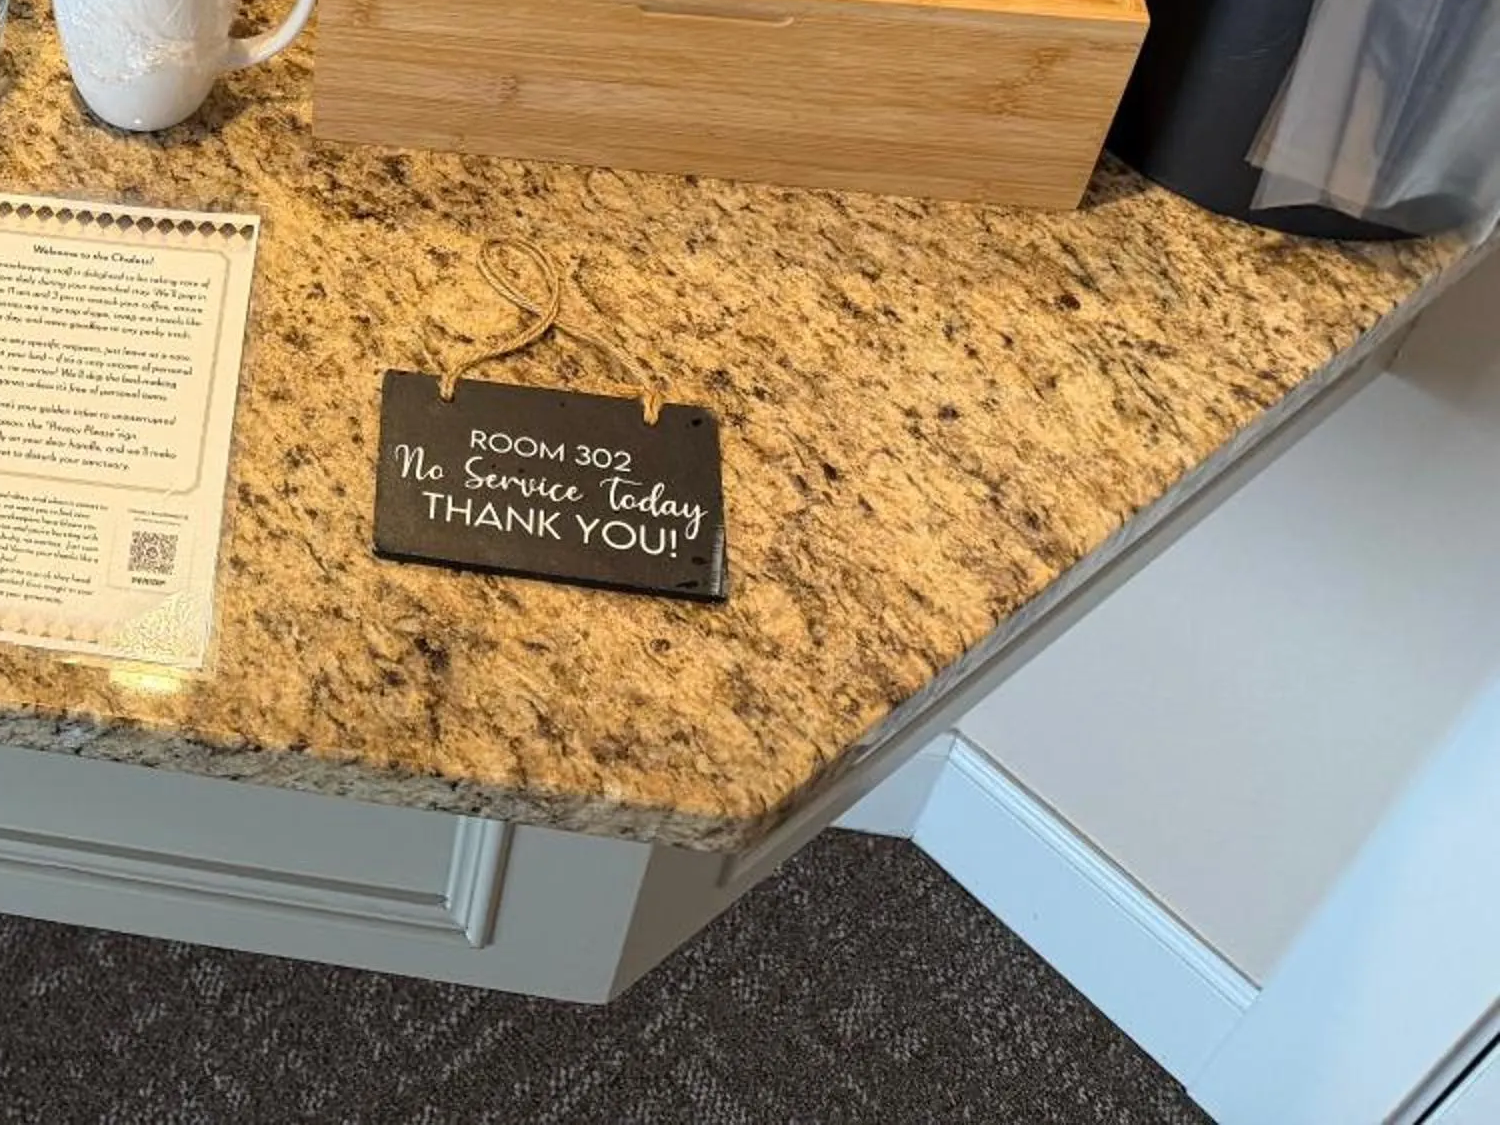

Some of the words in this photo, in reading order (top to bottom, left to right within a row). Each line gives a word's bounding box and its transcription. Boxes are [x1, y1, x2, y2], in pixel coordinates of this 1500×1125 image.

[470, 429, 566, 462] ROOM
[574, 444, 632, 472] 302
[394, 443, 444, 481] No
[463, 455, 584, 503] Service
[599, 476, 708, 541] Today
[421, 491, 562, 540] THANK
[575, 513, 679, 559] YOU!
